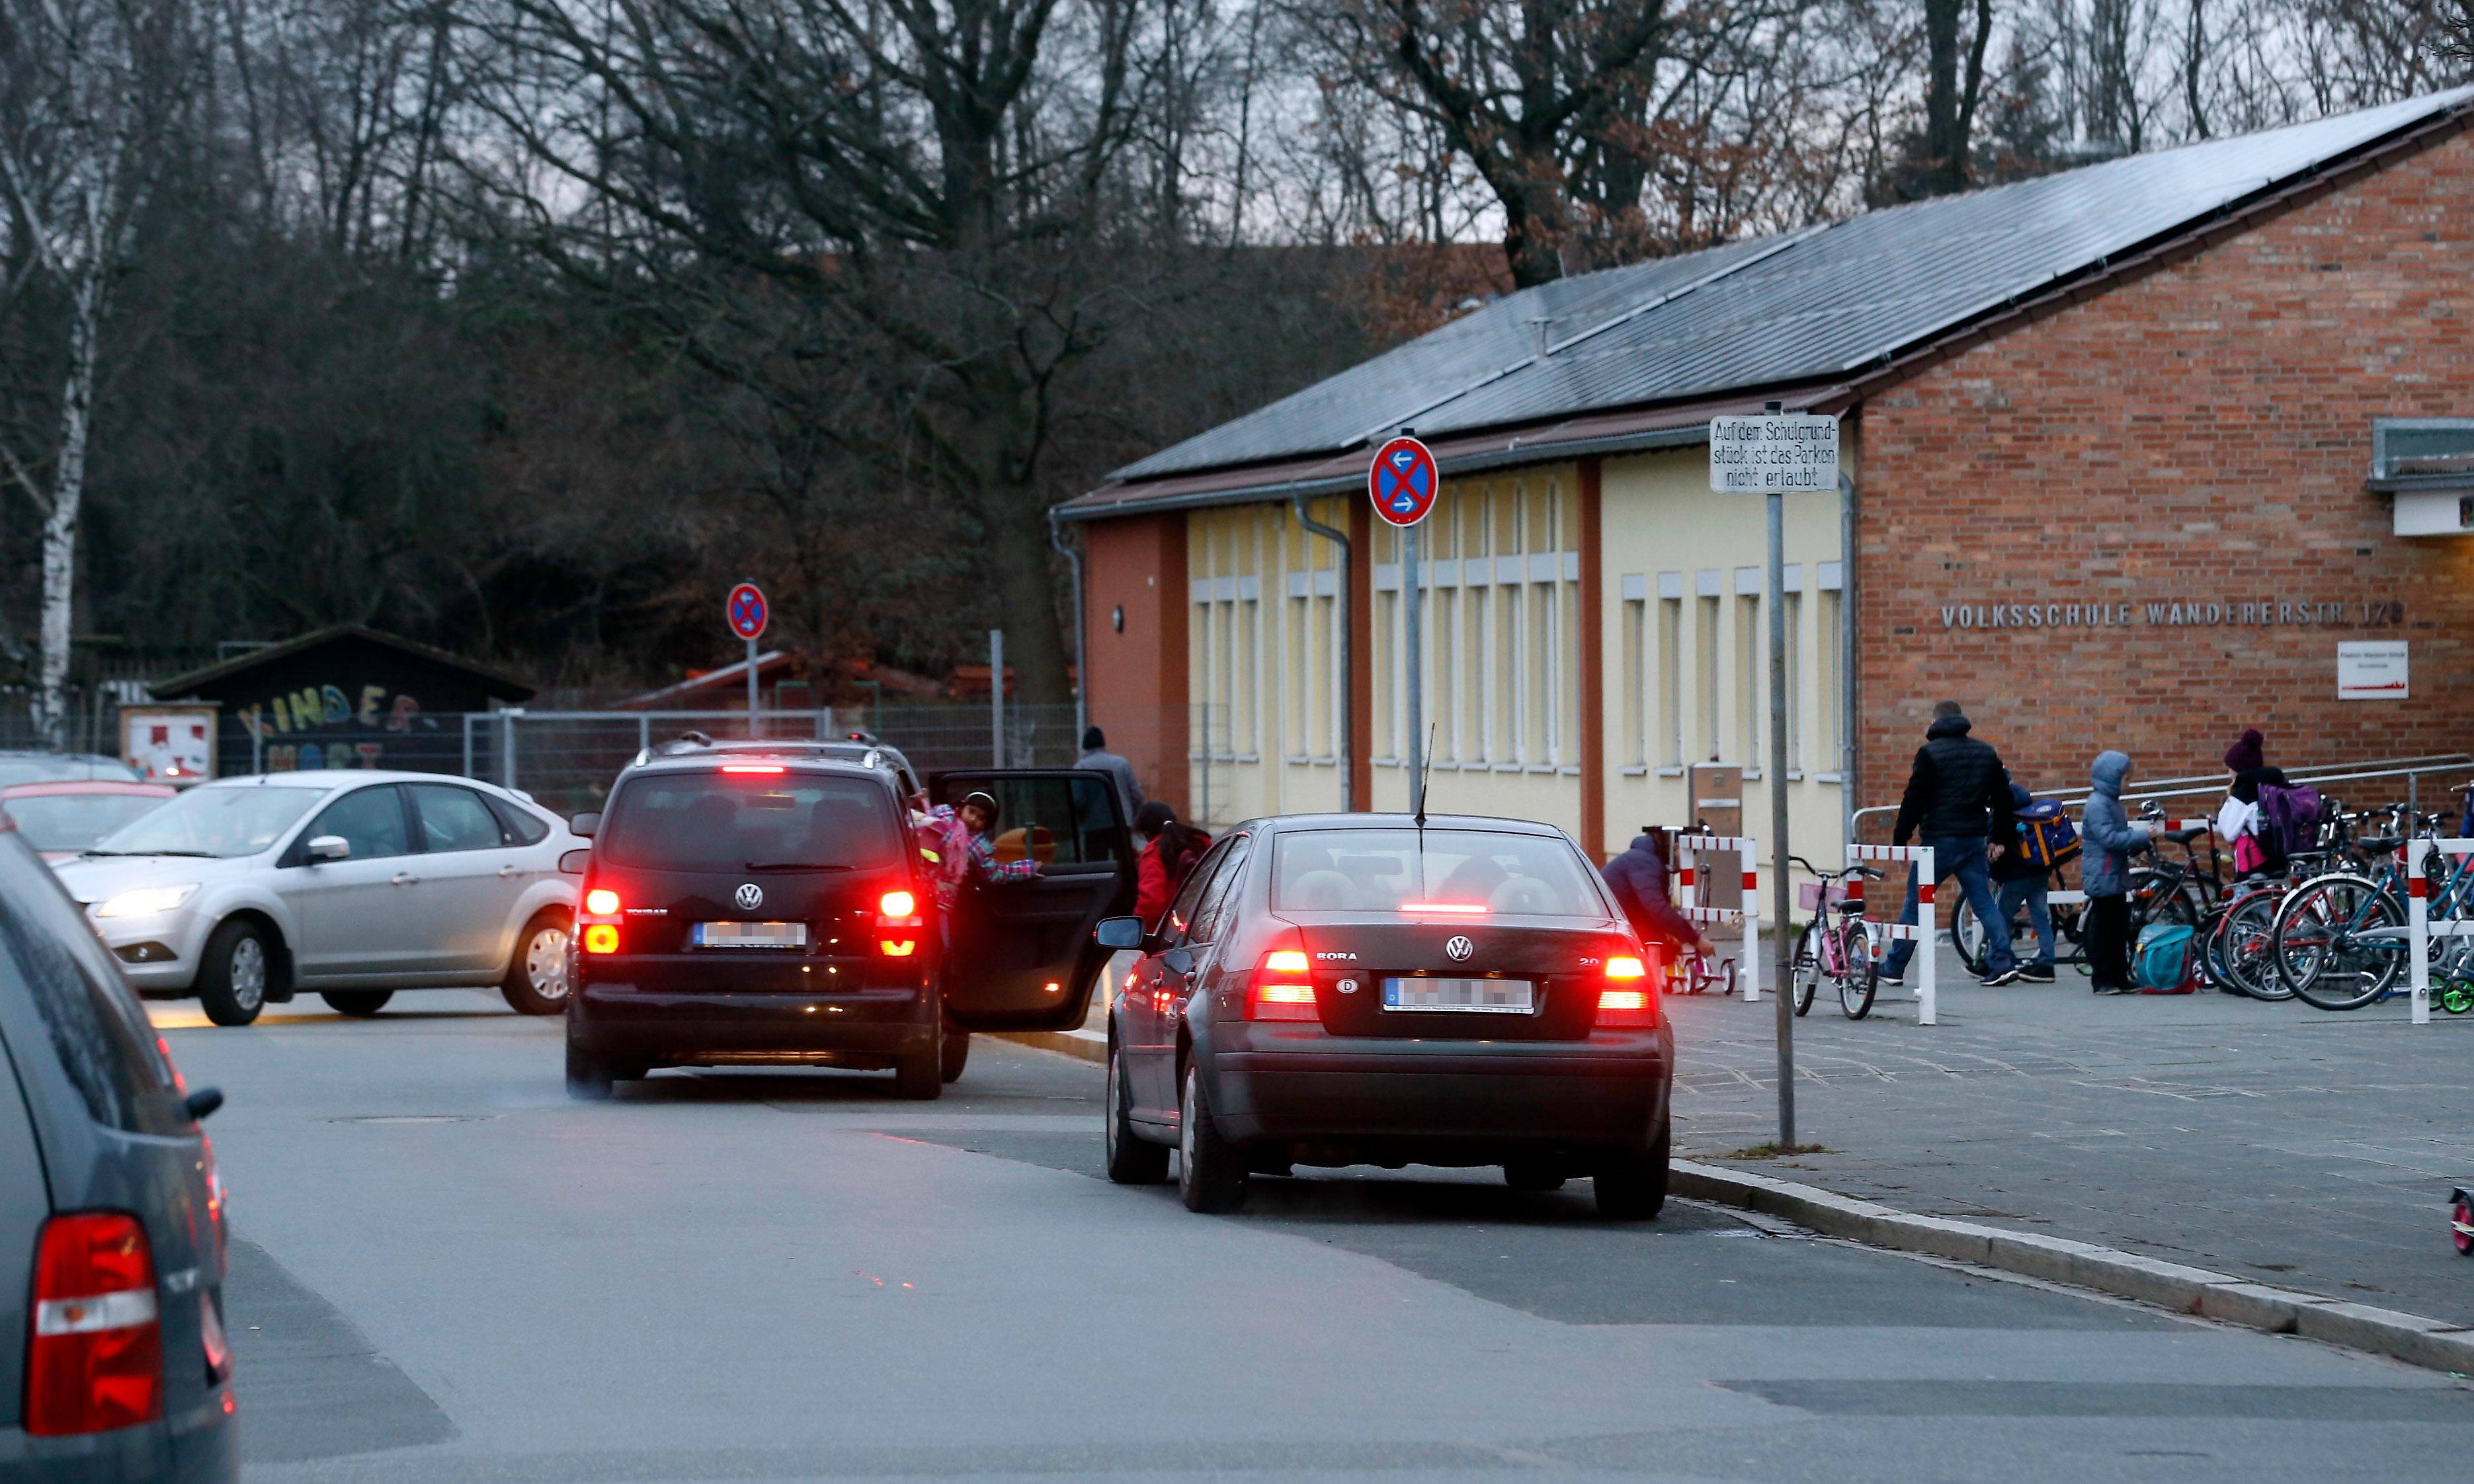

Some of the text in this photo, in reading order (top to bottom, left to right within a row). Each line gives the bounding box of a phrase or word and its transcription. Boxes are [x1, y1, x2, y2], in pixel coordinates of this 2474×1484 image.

[1714, 421, 1836, 444] Auf dem Schulgrund-
[1713, 444, 1835, 464] stück ist das Parken
[1727, 467, 1819, 487] nicht erlaubt
[1941, 602, 2131, 629] VOLKSSCHULE
[237, 684, 421, 738] KINDER
[1316, 952, 1358, 960] BORA
[1344, 981, 1352, 991] D
